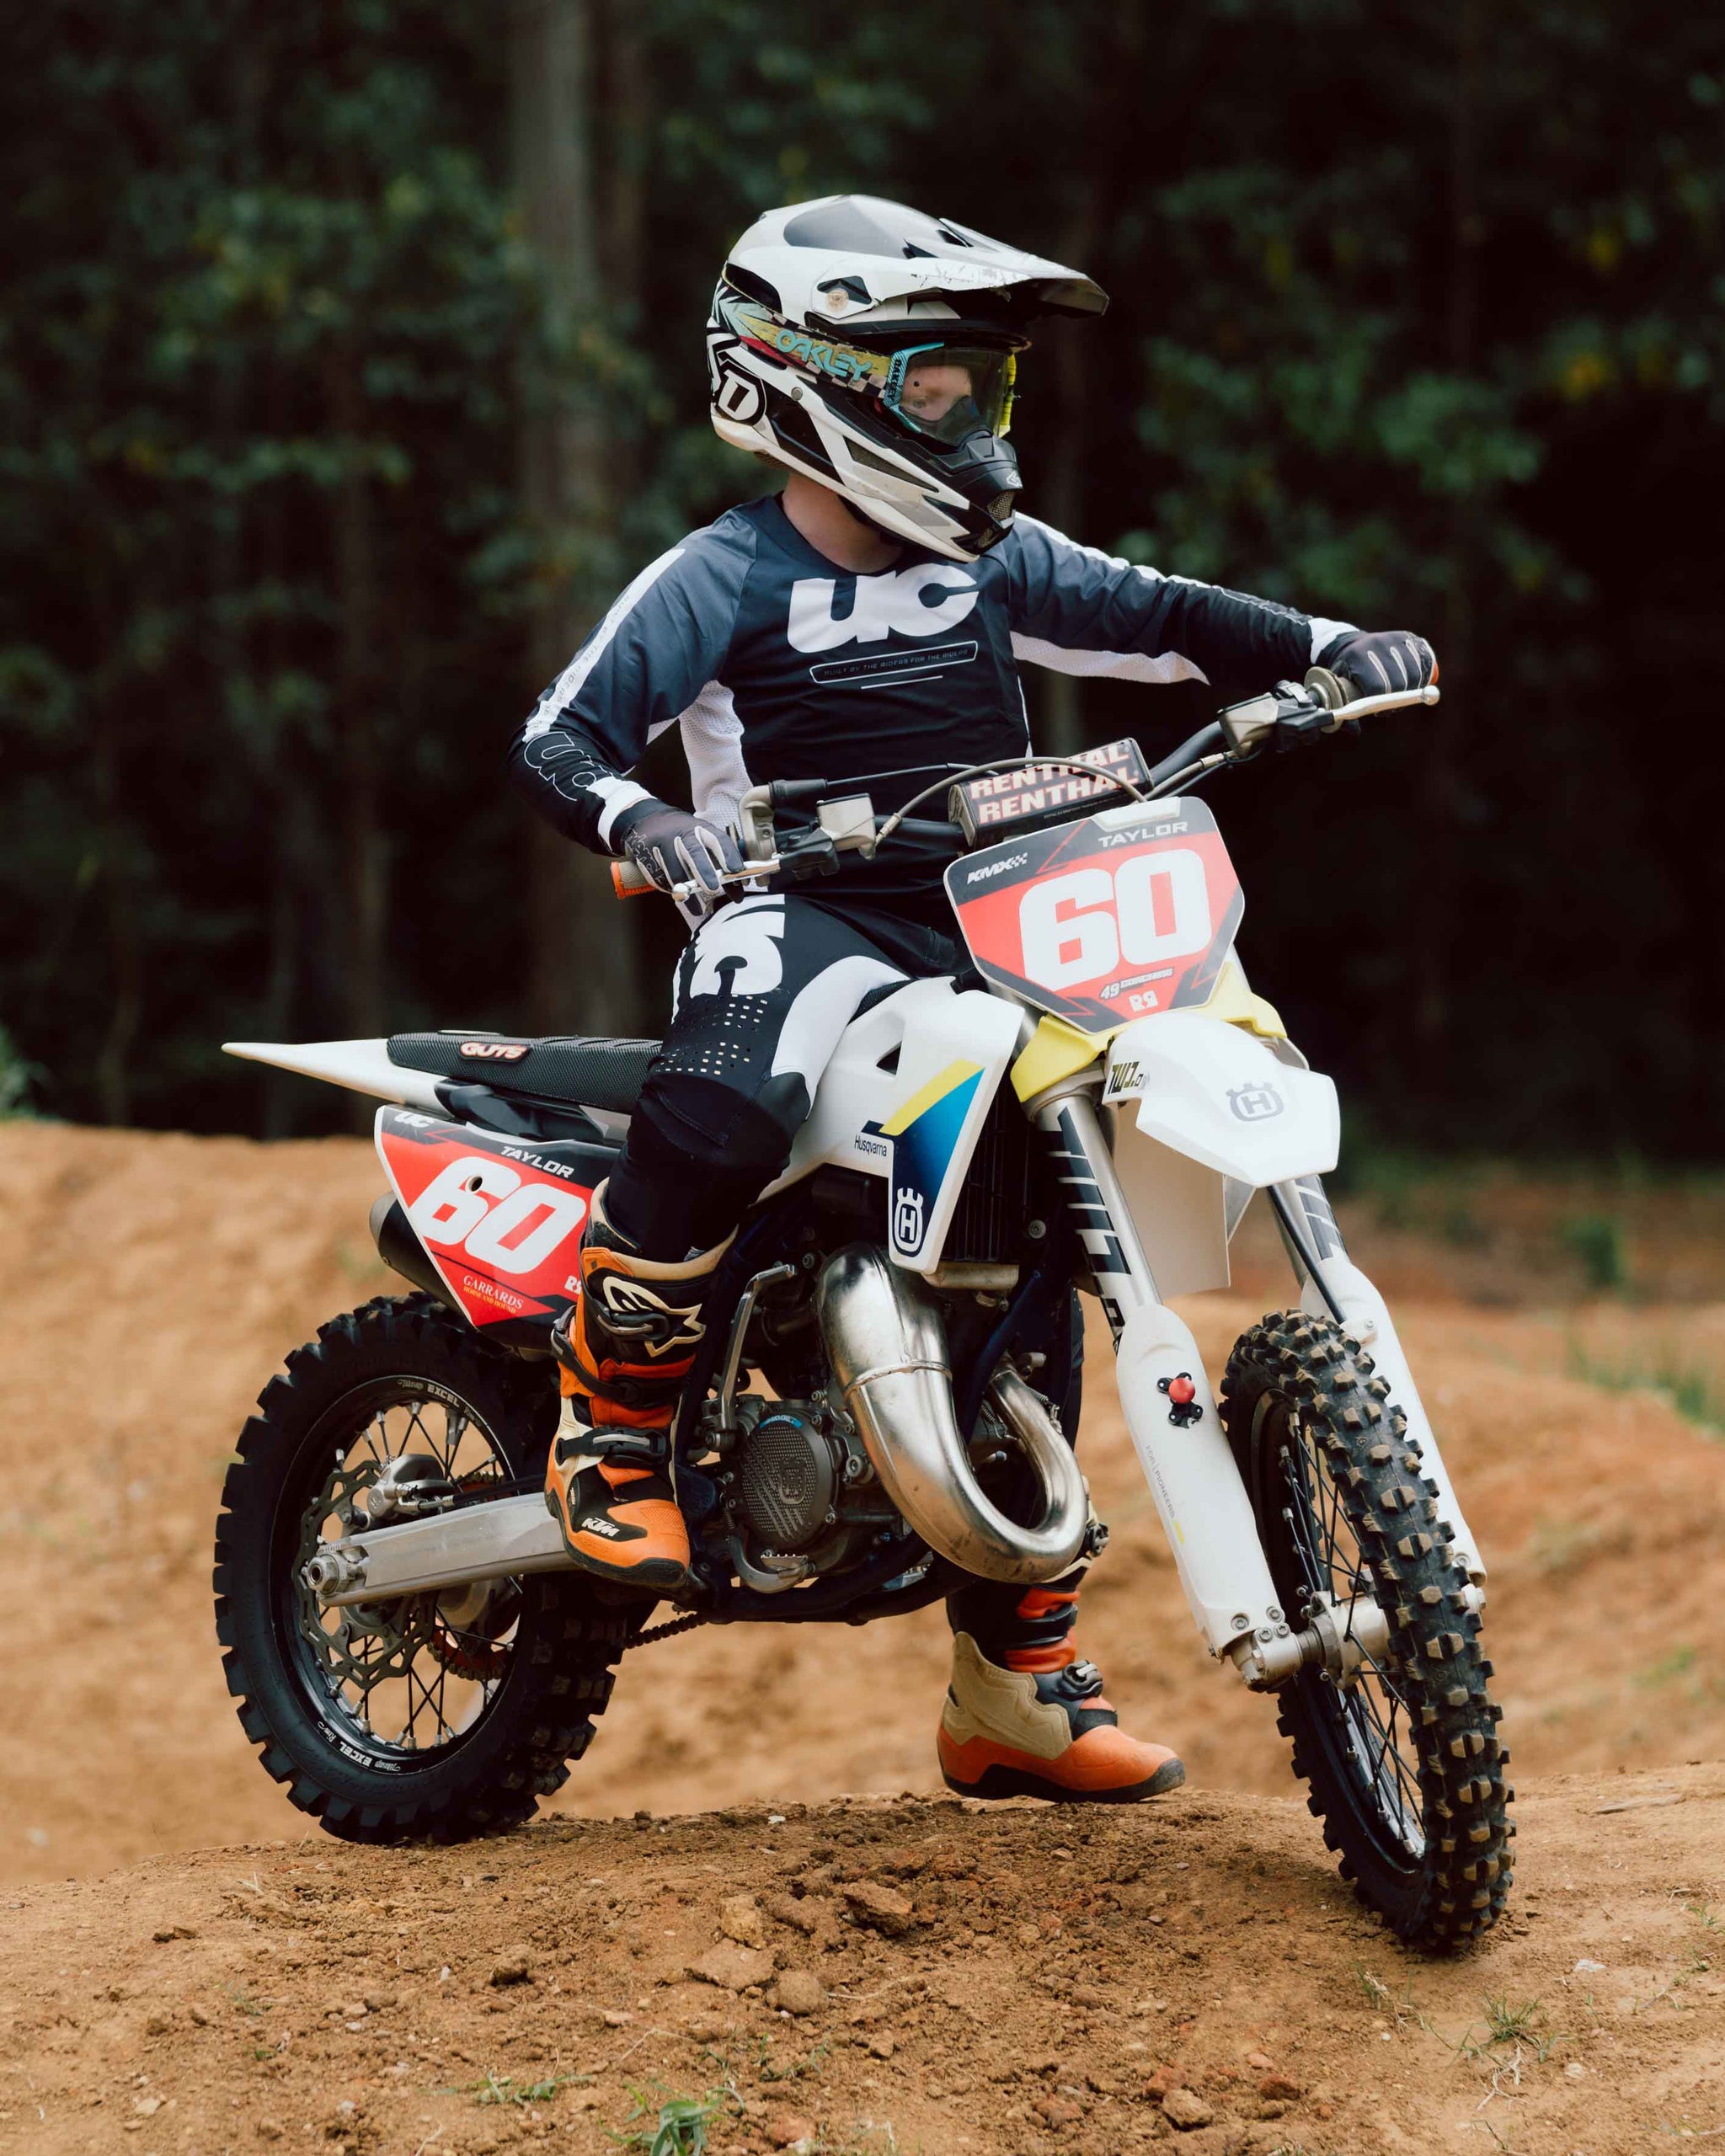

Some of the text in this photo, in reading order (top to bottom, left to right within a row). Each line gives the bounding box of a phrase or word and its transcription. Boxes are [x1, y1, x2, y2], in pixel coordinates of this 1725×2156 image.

[775, 328, 873, 382] OAKLEY
[970, 744, 1130, 800] RENTHAL
[978, 766, 1140, 825] RENTHAL
[1097, 821, 1188, 848] TAYLOR
[967, 858, 1013, 885] KMX
[1018, 848, 1212, 991] 60
[460, 1042, 528, 1060] GUTS
[854, 1135, 888, 1157] Husqvarna
[501, 1146, 575, 1179] TAYLOR
[409, 1155, 587, 1275] 60
[463, 1274, 524, 1309] GARRARDS
[483, 1293, 494, 1305] AND
[427, 1384, 460, 1407] EXCEL
[581, 1517, 621, 1537] KTM
[339, 1741, 373, 1768] EXCEL
